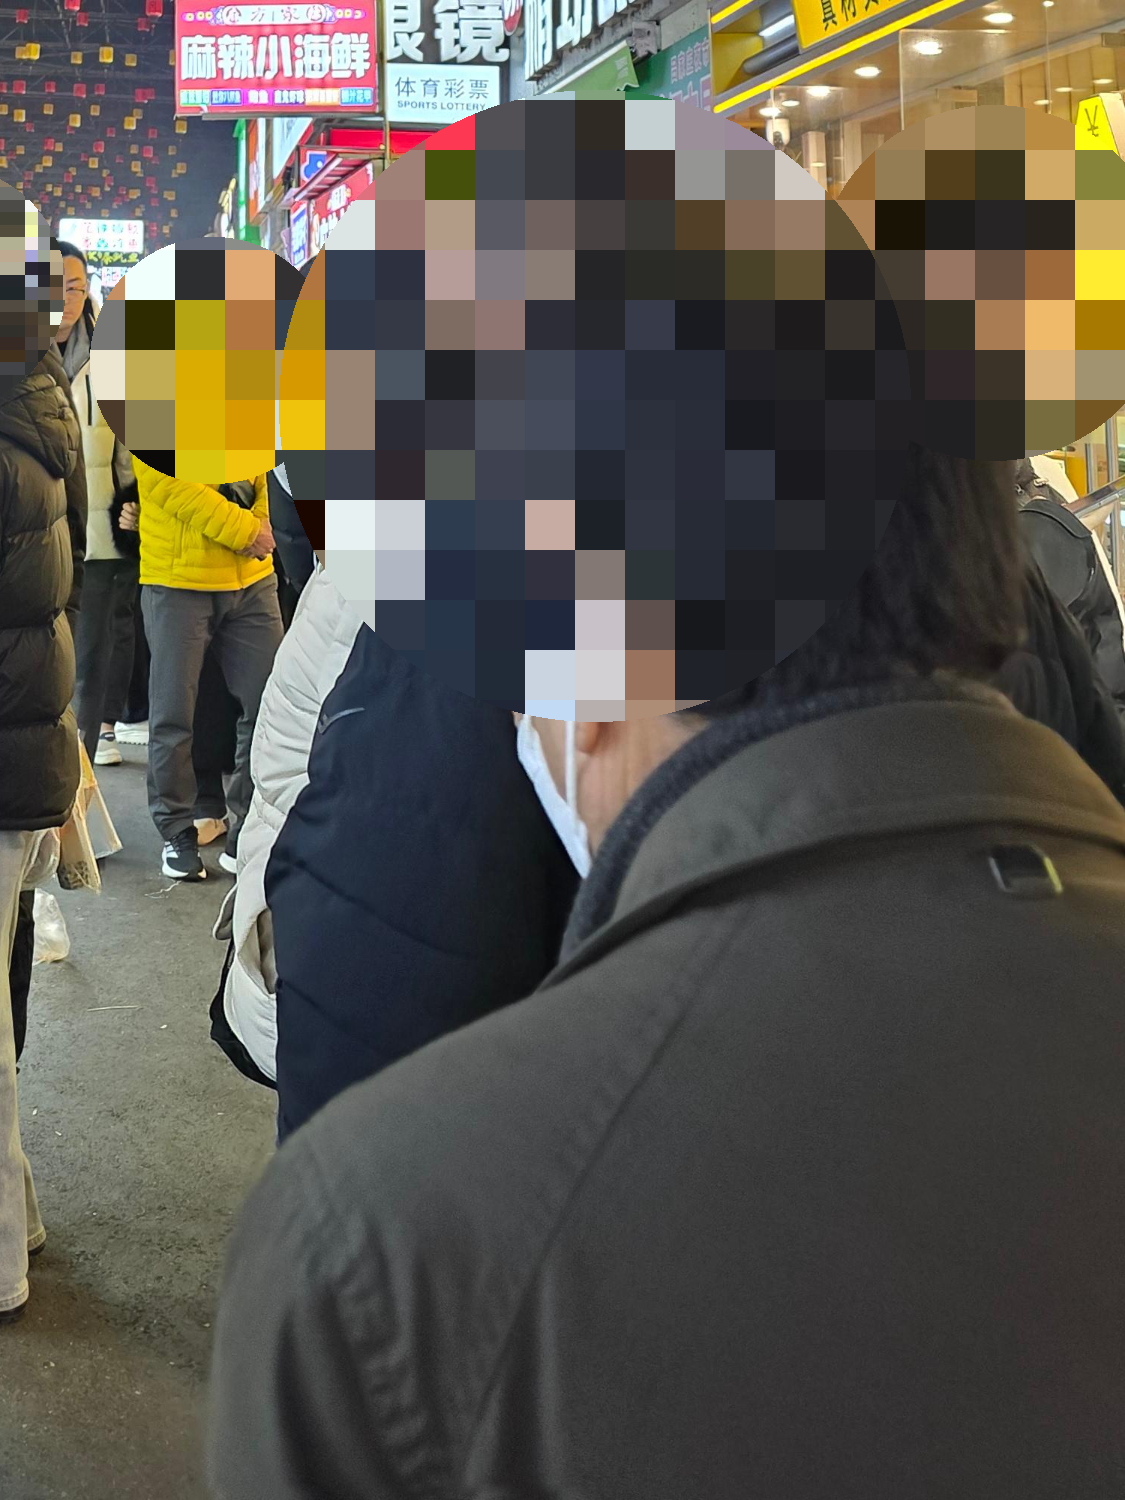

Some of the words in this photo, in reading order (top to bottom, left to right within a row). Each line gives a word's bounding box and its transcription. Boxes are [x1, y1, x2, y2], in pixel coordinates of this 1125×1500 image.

[180, 33, 371, 81] 麻辣小海鲜
[395, 76, 489, 100] 体育彩票
[397, 100, 438, 110] SPORTS
[441, 101, 486, 111] LOTTERY
